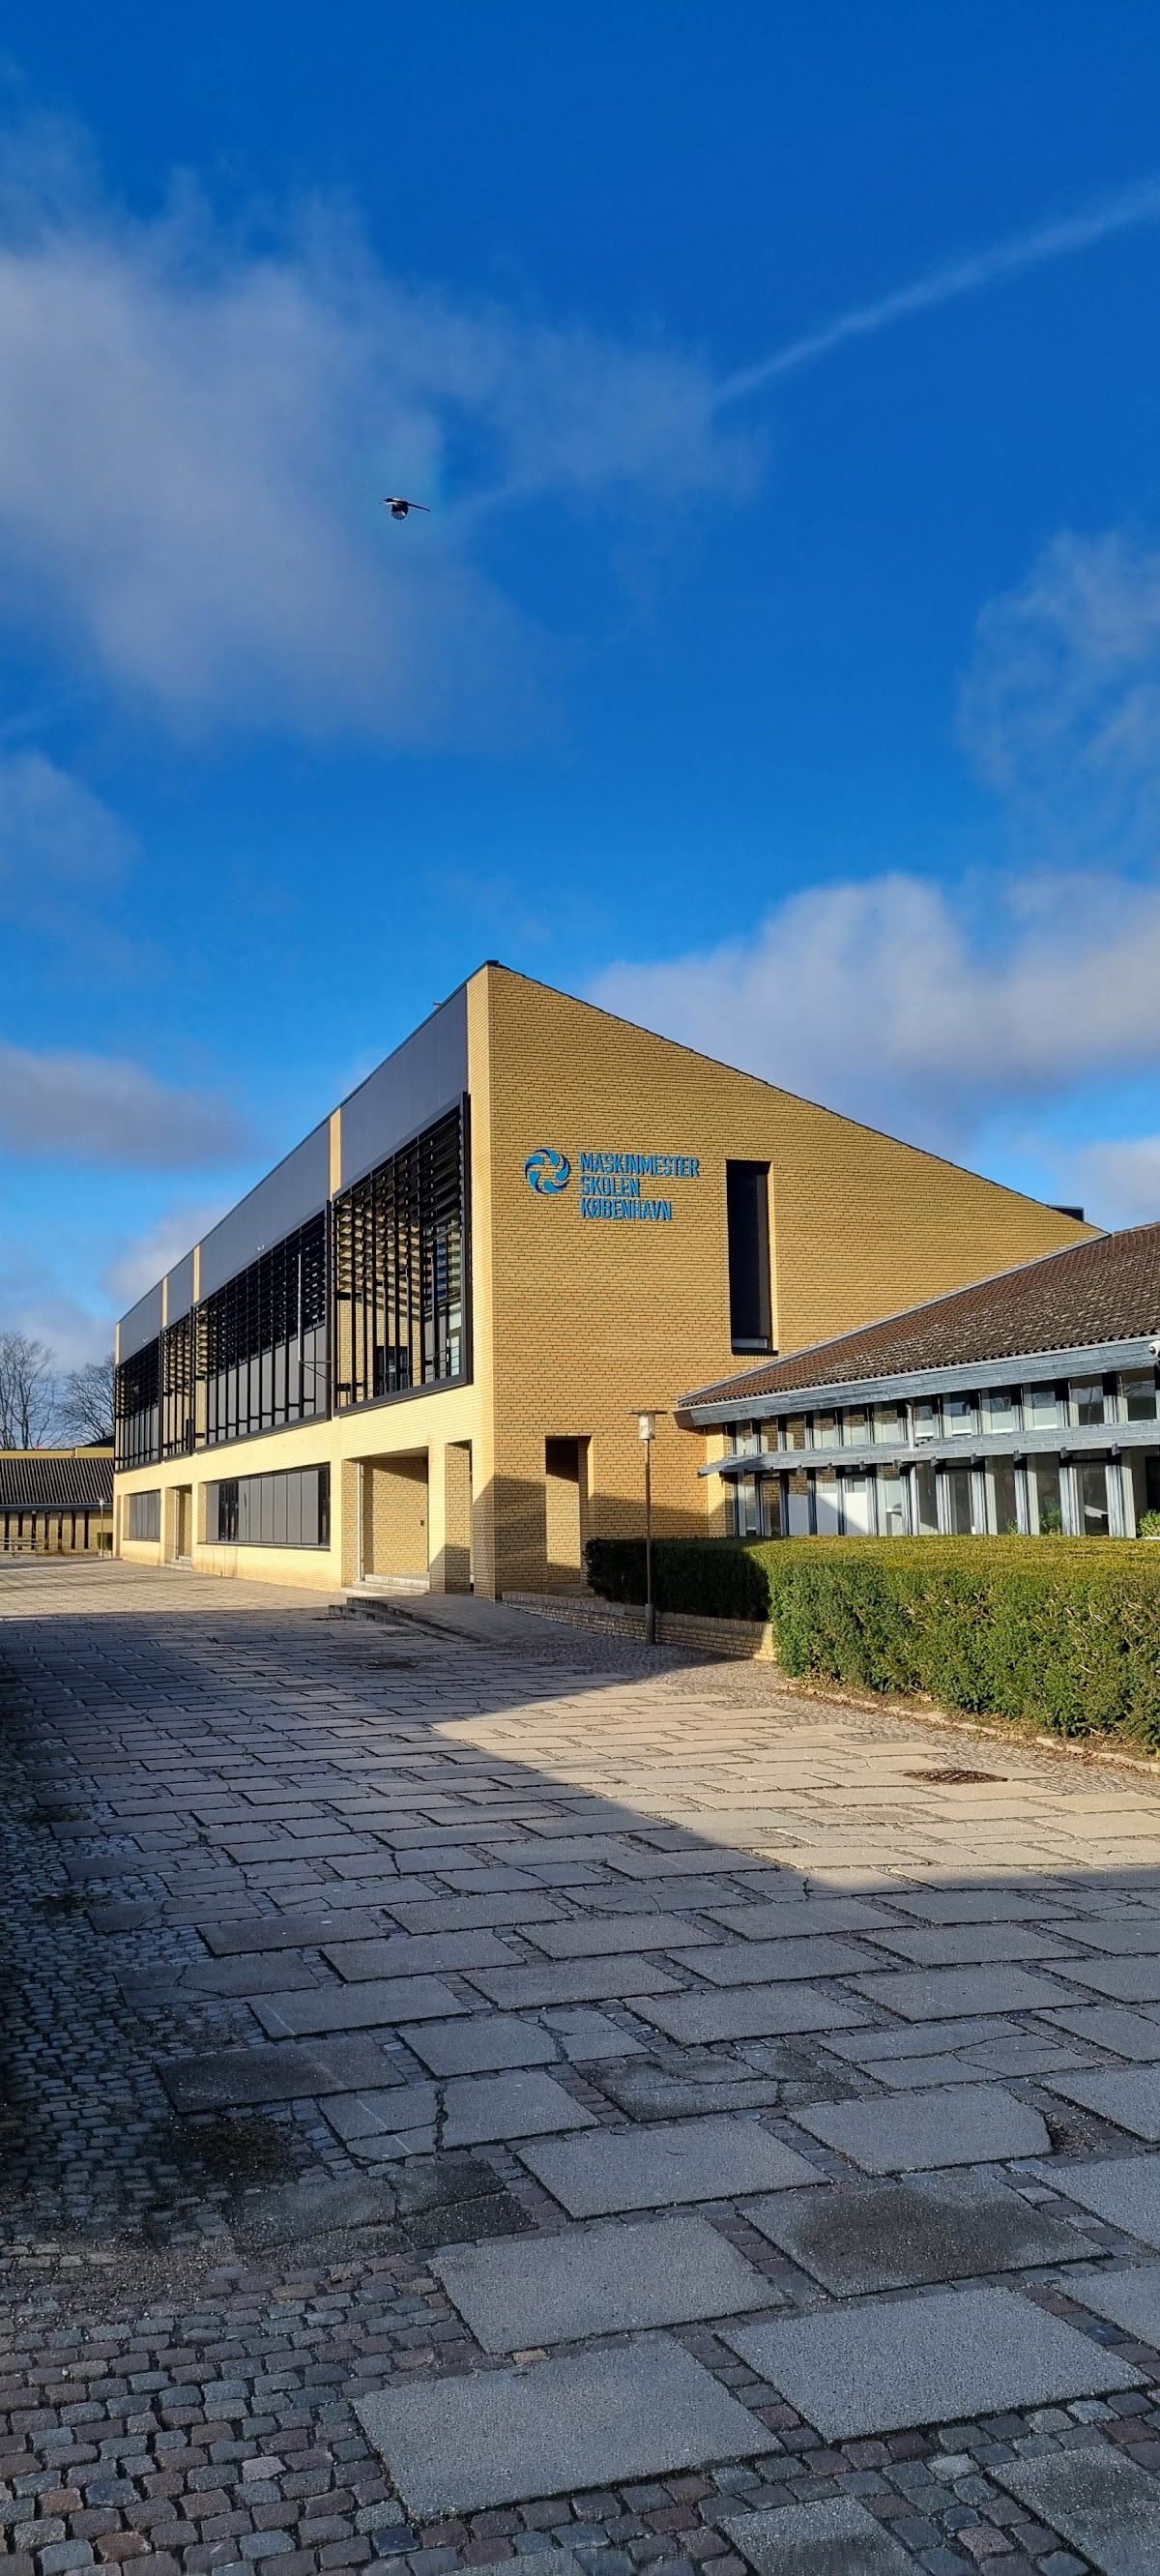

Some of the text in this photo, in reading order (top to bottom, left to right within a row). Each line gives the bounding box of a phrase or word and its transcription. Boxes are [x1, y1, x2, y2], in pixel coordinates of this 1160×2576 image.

[580, 1152, 700, 1178] MASKINMESTER
[580, 1175, 640, 1197] SKOLEN
[580, 1198, 672, 1221] KØBENHAVN
